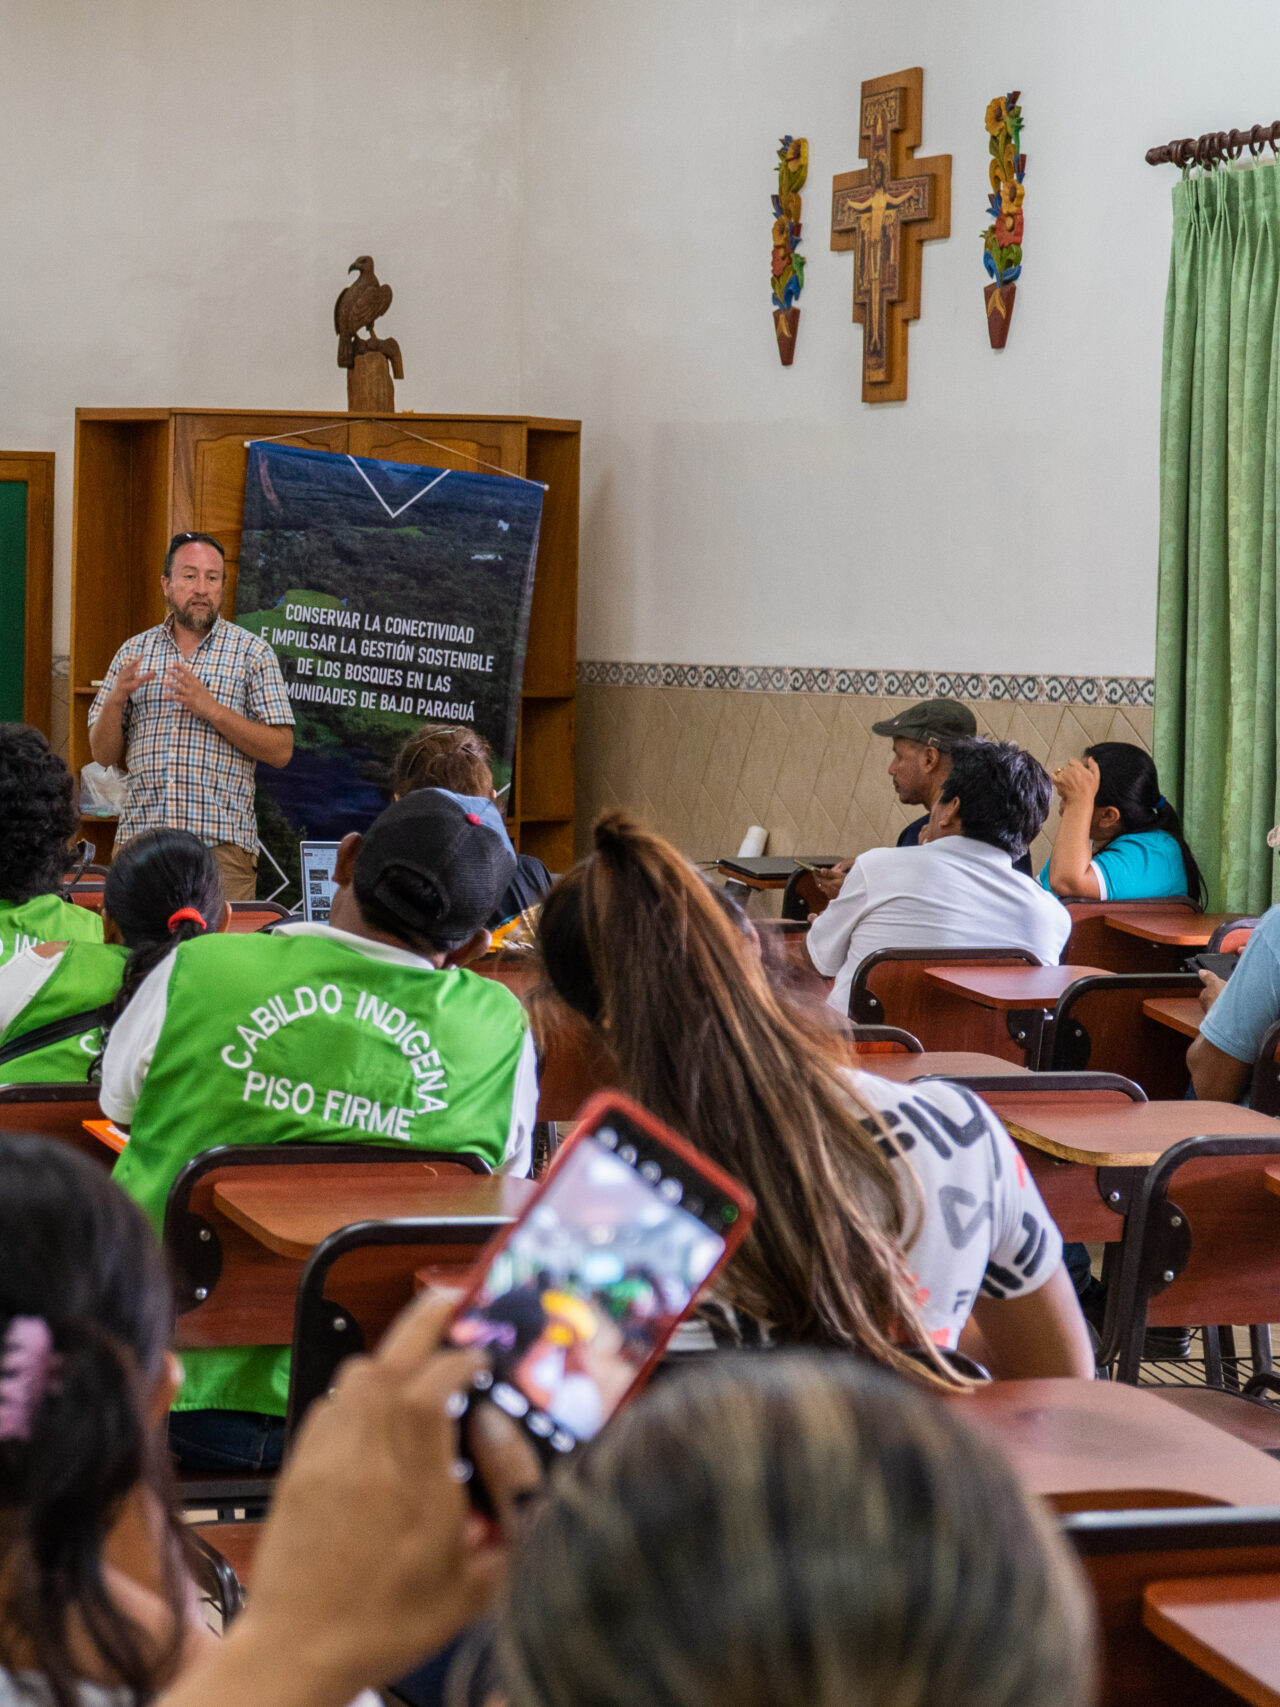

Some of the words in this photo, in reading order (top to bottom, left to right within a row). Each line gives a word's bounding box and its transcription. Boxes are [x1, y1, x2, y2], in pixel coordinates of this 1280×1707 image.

[285, 604, 361, 629] CONSERVAR
[364, 613, 381, 632] LA
[385, 616, 475, 644] CONECTIVIDAD
[271, 628, 337, 652] IMPULSAR
[340, 636, 357, 655] LA
[360, 640, 415, 662] GESTIÓN
[418, 647, 495, 672] SOSTENIBLE
[296, 657, 314, 675] DE
[316, 659, 341, 679] LOS
[344, 663, 403, 687] BOSQUES
[406, 671, 424, 689] EN
[426, 673, 452, 693] LAS
[284, 681, 357, 707] MUNIDADES
[360, 691, 377, 709] DE
[380, 693, 413, 714] BAJO
[416, 698, 475, 721] PARAGUÁ
[221, 983, 343, 1070] CABILDO
[354, 990, 449, 1116] INDIGENA
[242, 1070, 316, 1116] PISO
[322, 1089, 416, 1141] FIRME
